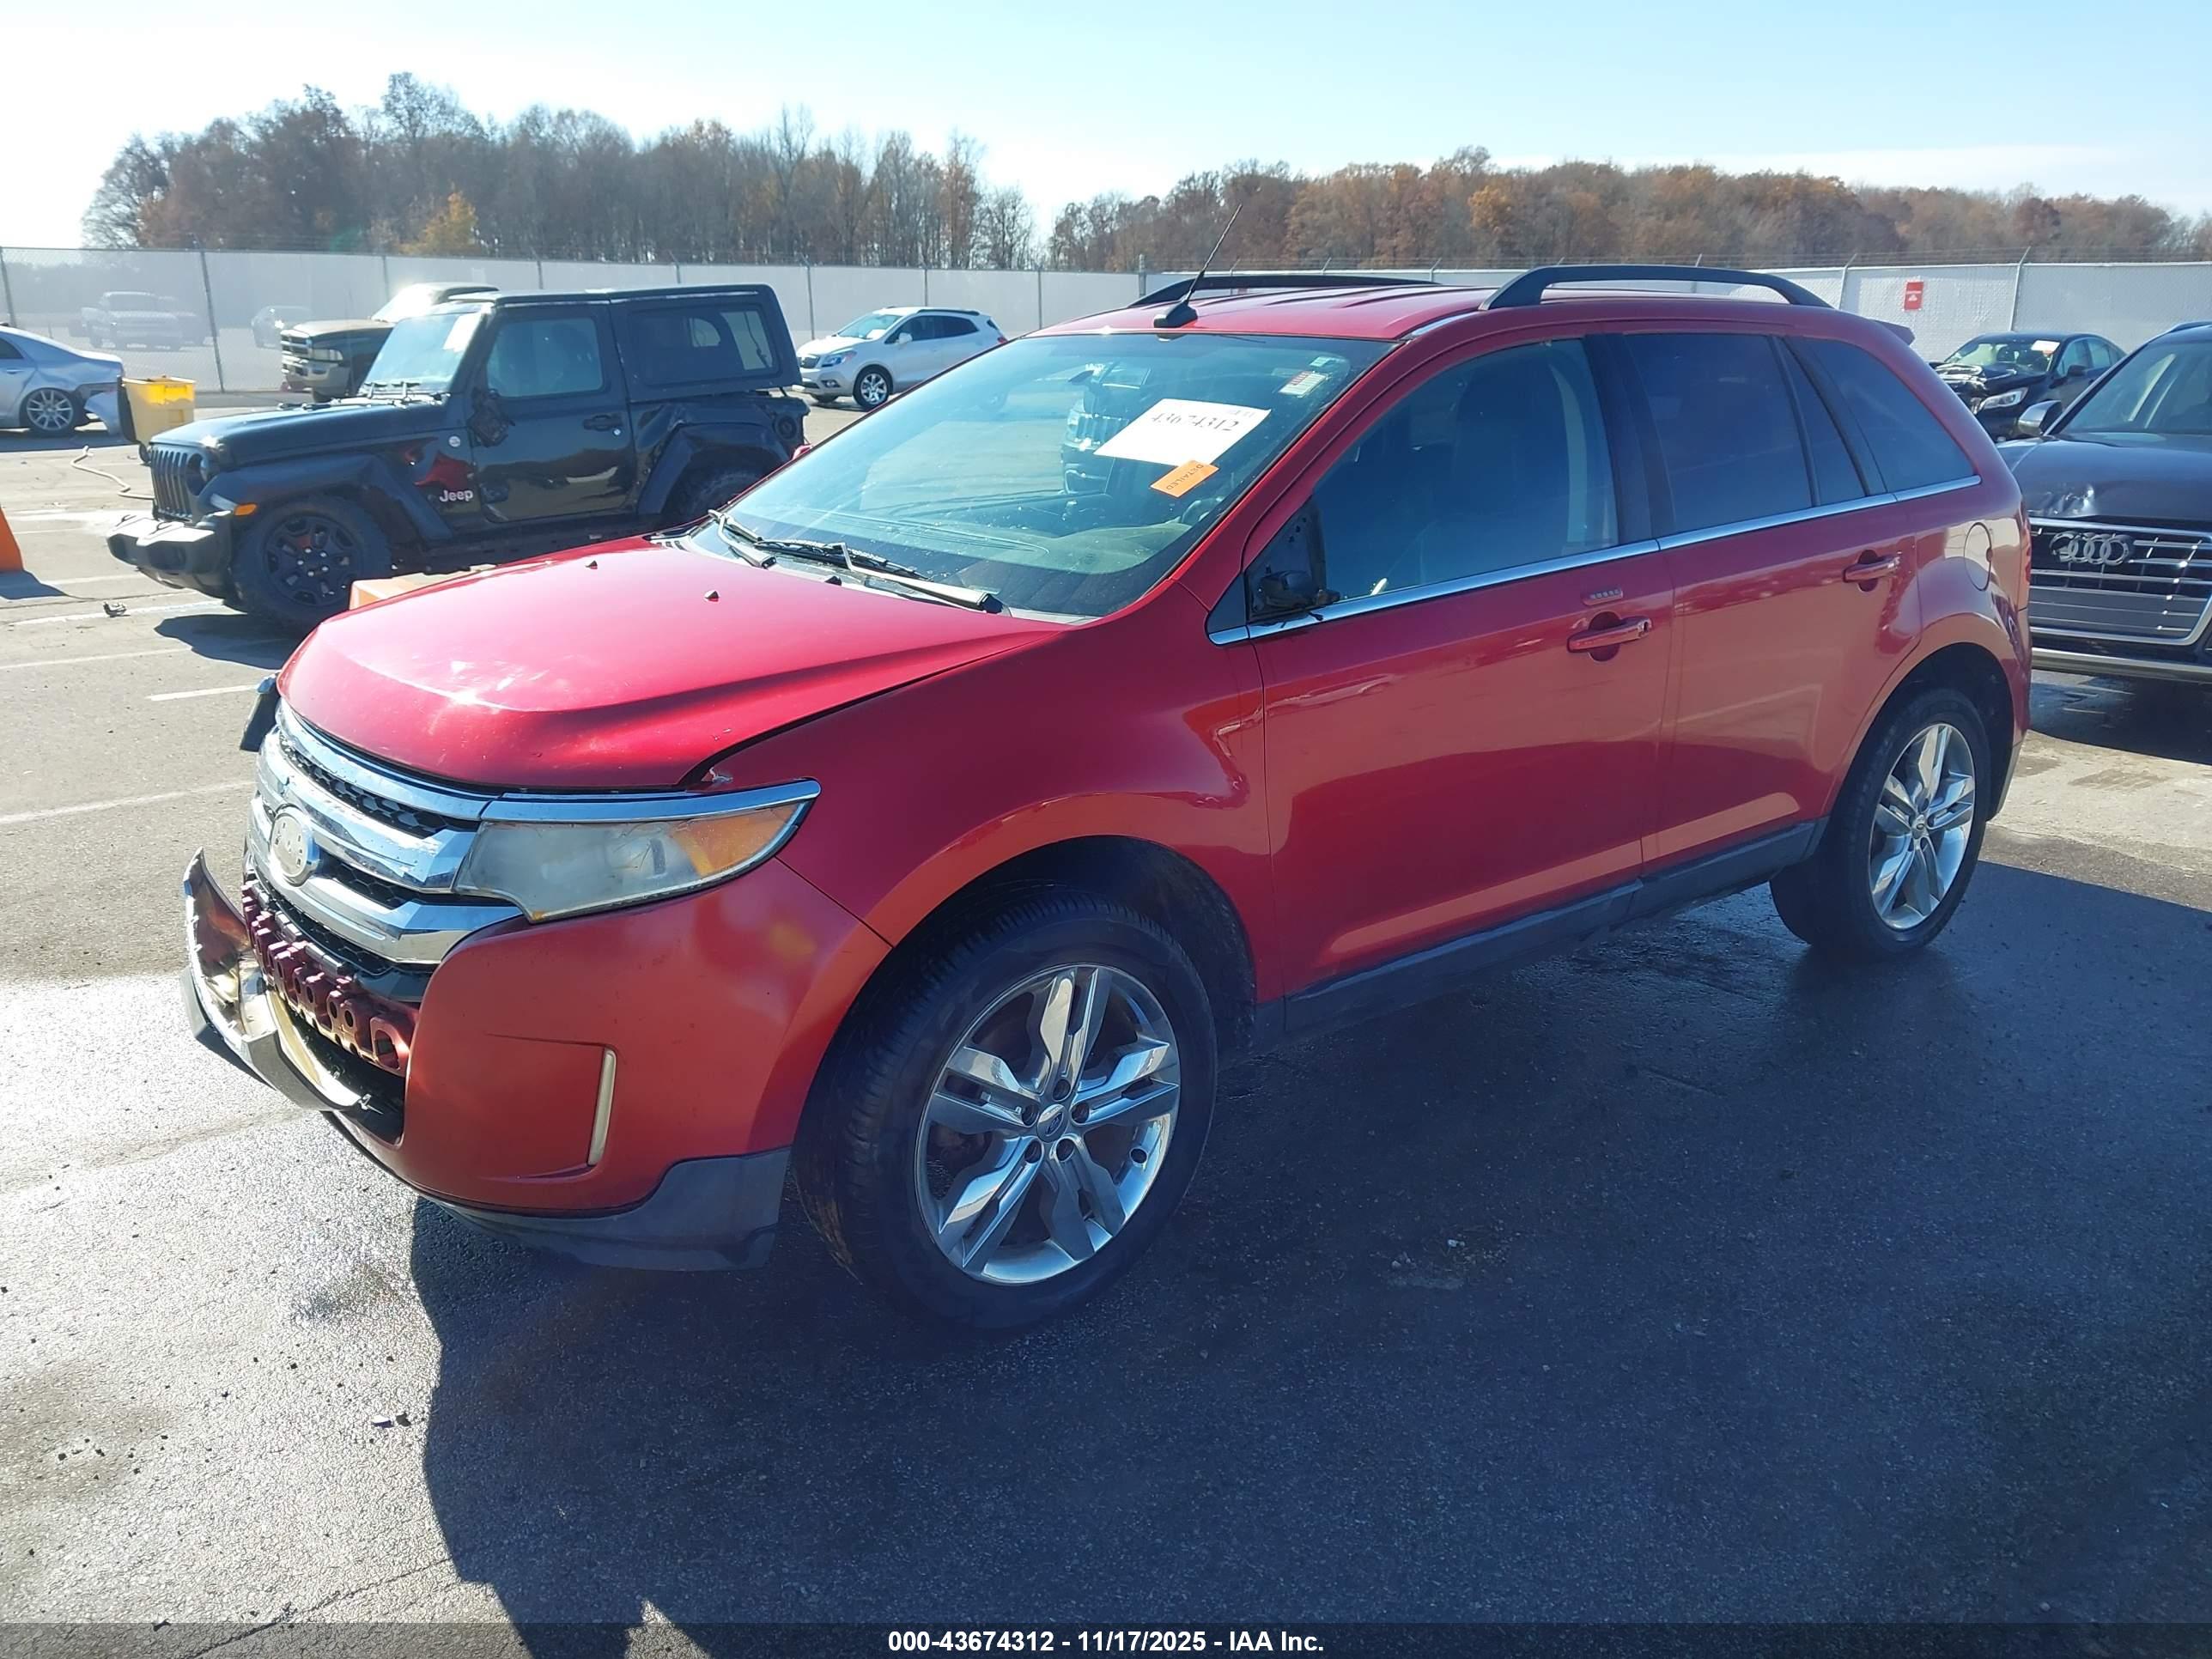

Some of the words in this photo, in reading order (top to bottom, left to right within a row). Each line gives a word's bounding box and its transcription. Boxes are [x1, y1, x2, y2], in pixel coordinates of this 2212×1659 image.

[1152, 411, 1239, 431] 43674312
[1166, 464, 1204, 490] DETAILED
[439, 489, 473, 502] Jeep
